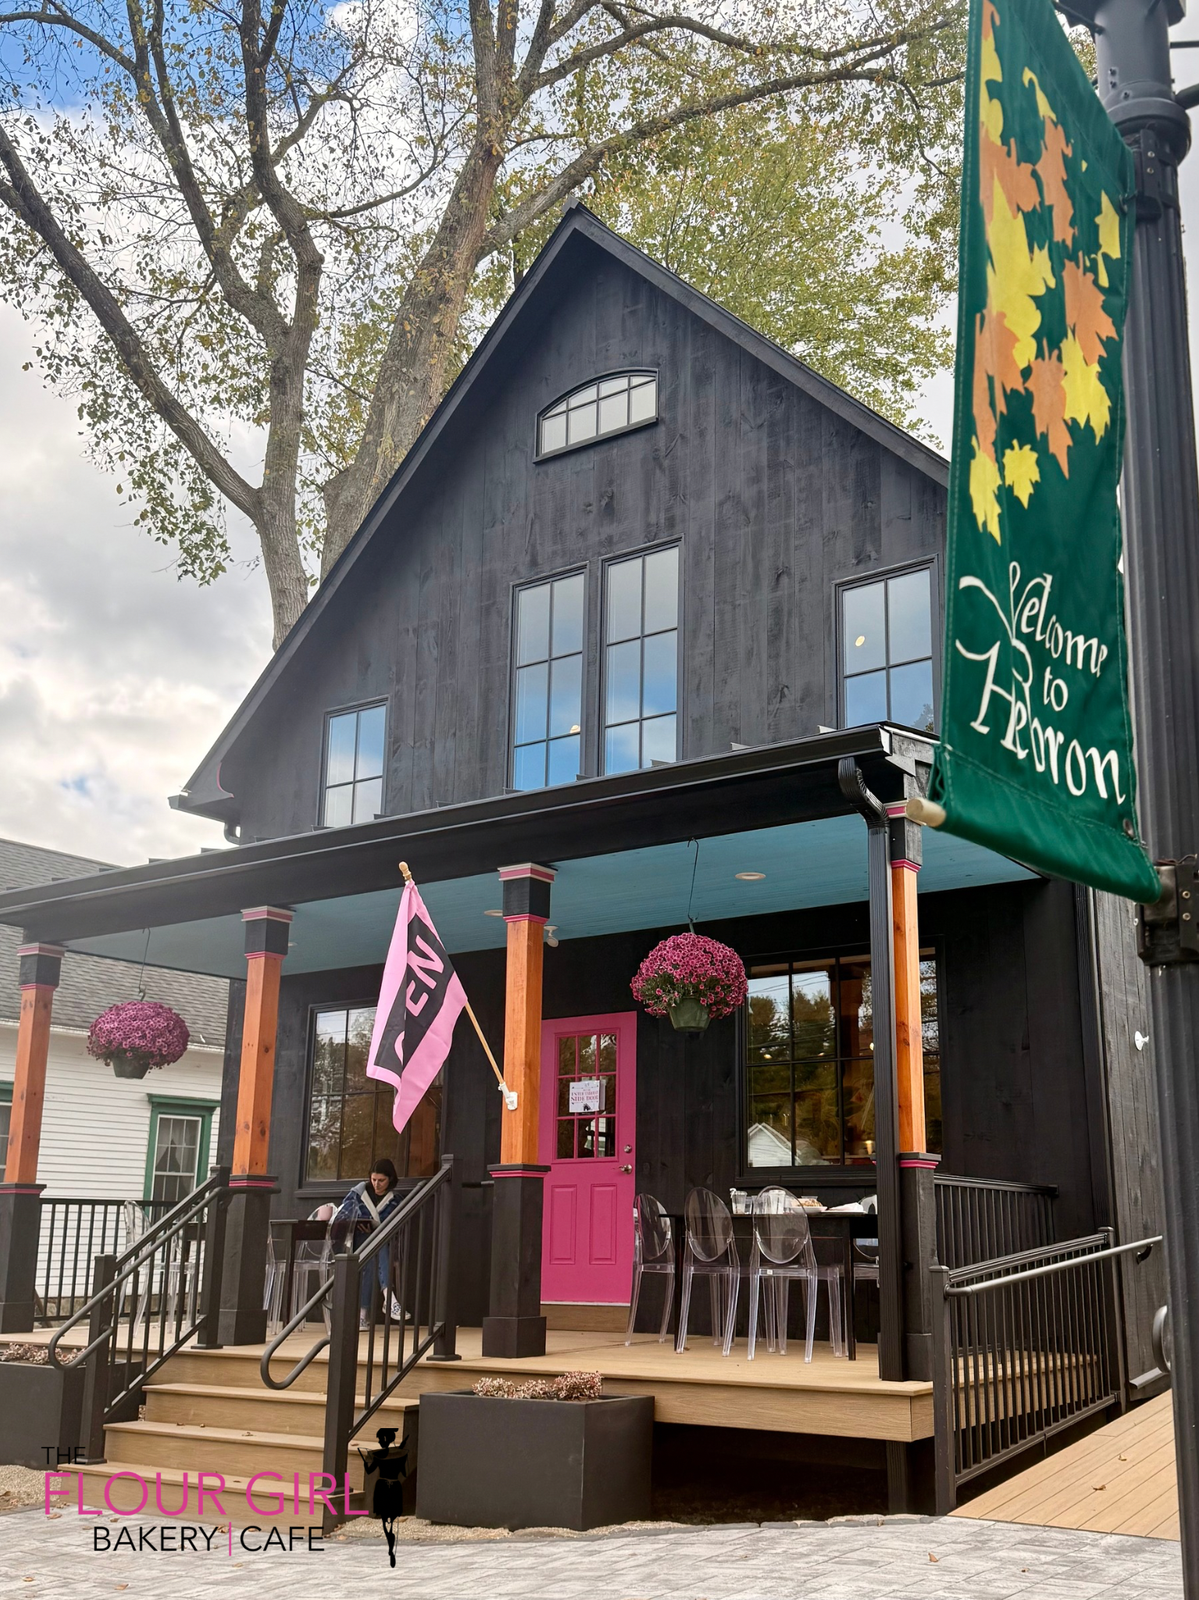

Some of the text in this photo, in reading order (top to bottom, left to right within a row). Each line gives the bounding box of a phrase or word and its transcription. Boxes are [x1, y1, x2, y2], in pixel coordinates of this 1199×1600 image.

[959, 561, 1108, 677] Welcome
[955, 638, 1126, 805] Hebron
[1043, 665, 1068, 711] to
